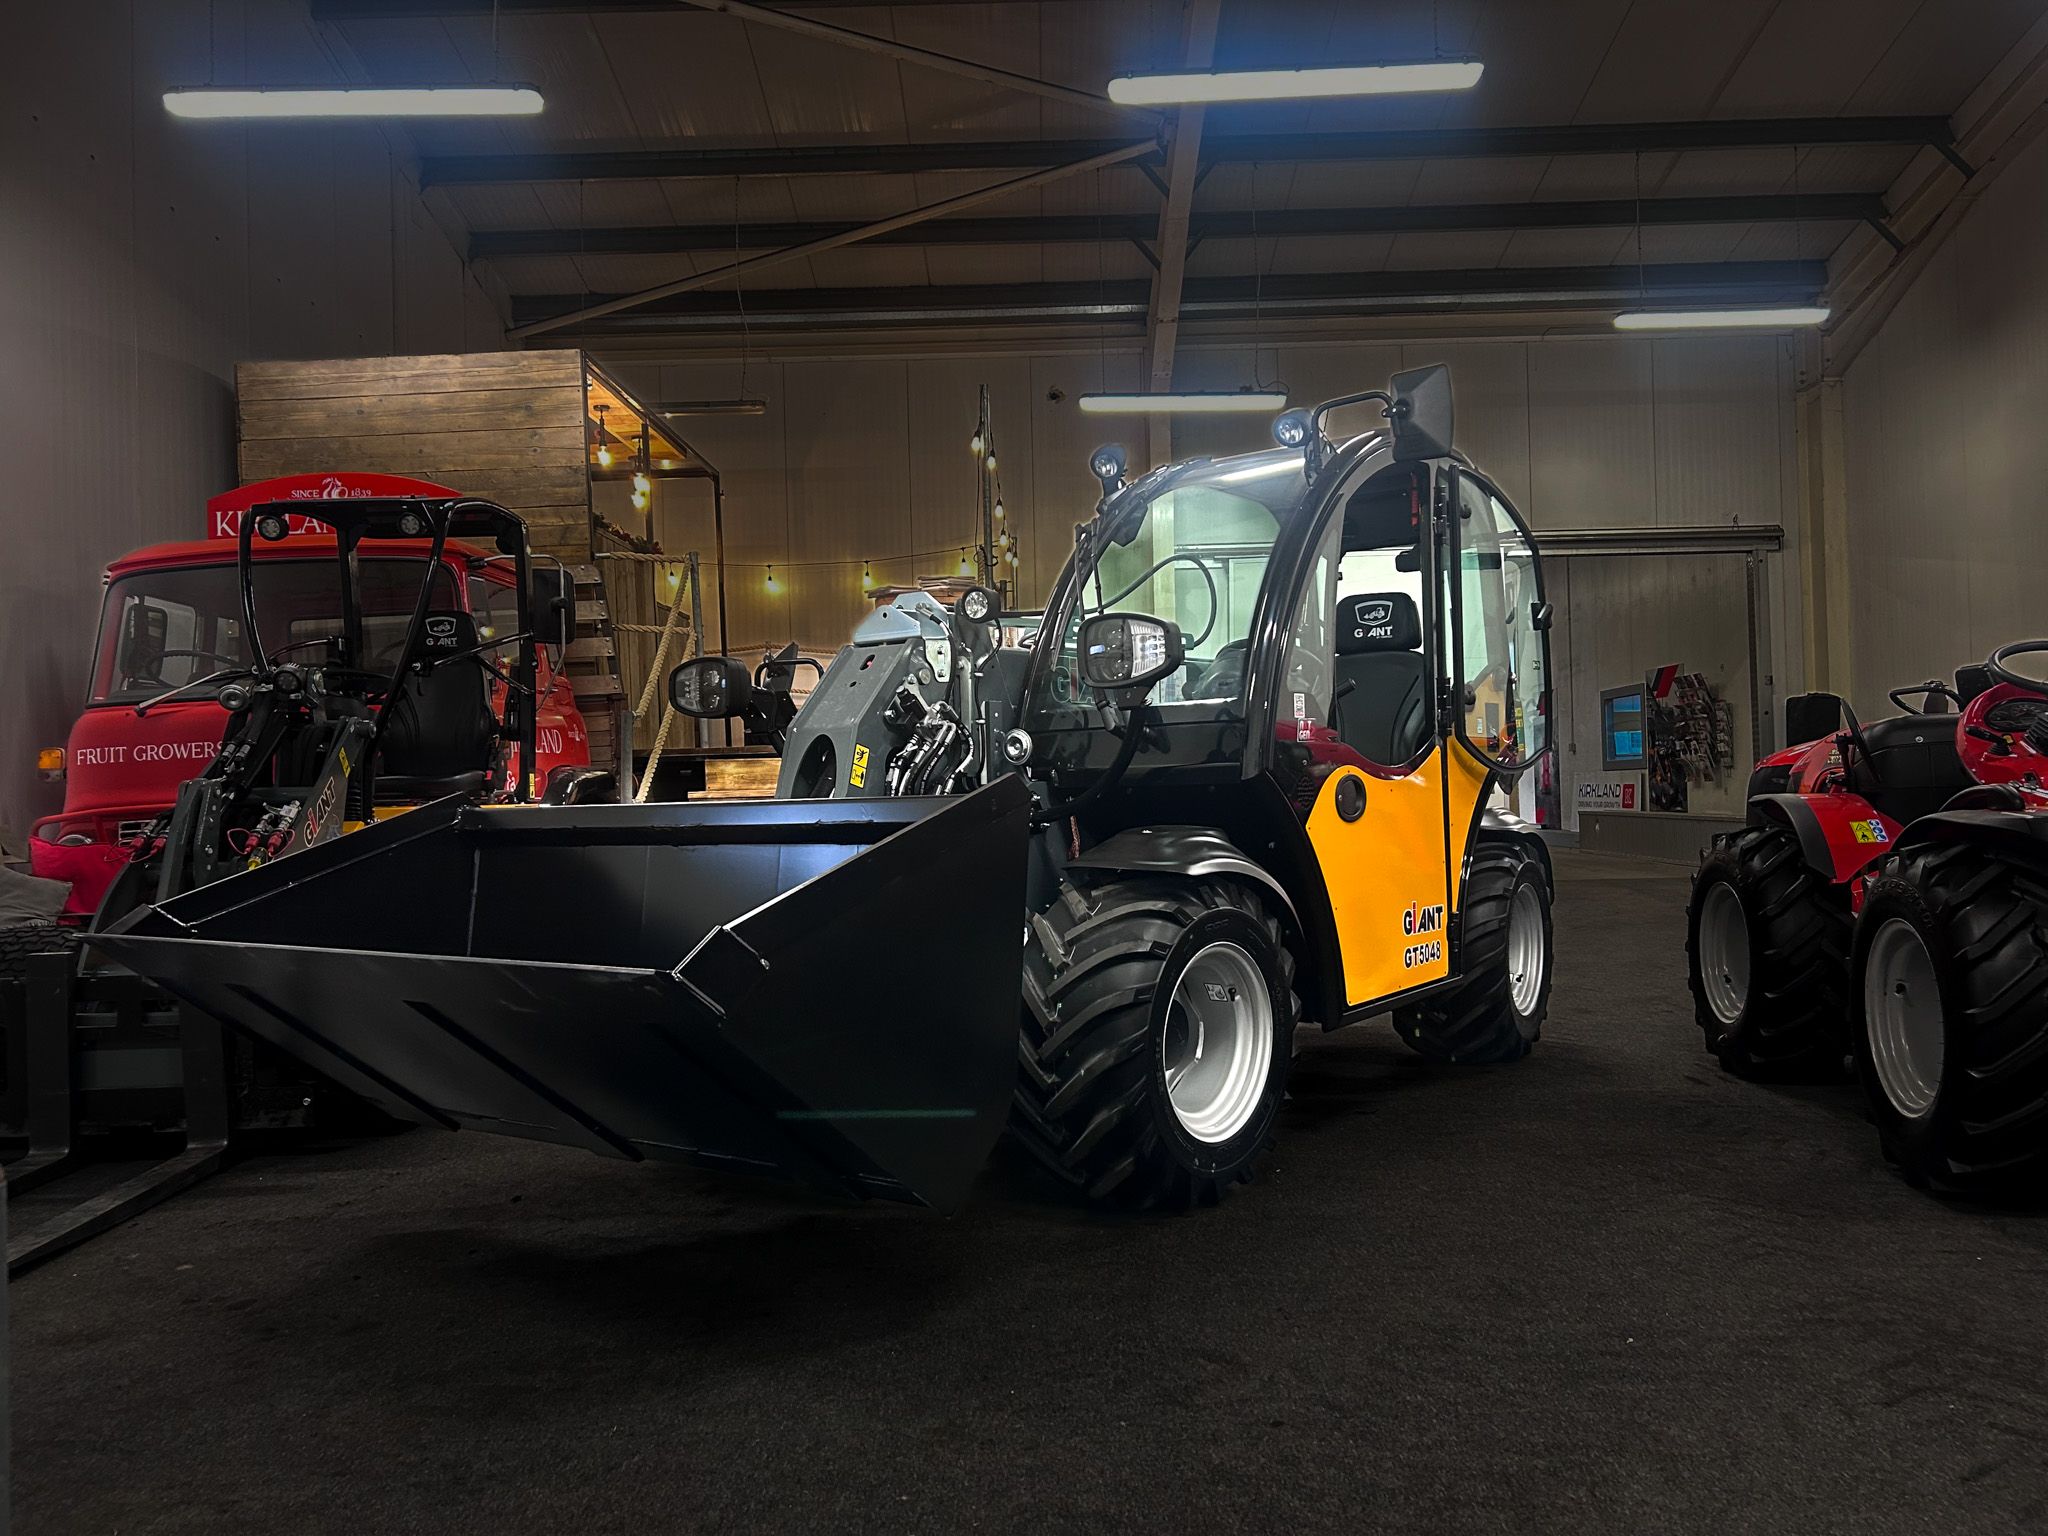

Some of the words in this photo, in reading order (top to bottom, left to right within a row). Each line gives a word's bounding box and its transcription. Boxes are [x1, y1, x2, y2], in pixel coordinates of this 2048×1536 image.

[291, 489, 320, 498] SINCE
[351, 488, 372, 497] 1839
[77, 746, 127, 765] FRUIT
[1579, 784, 1621, 798] KIRKLAND
[1404, 940, 1441, 969] GT5048
